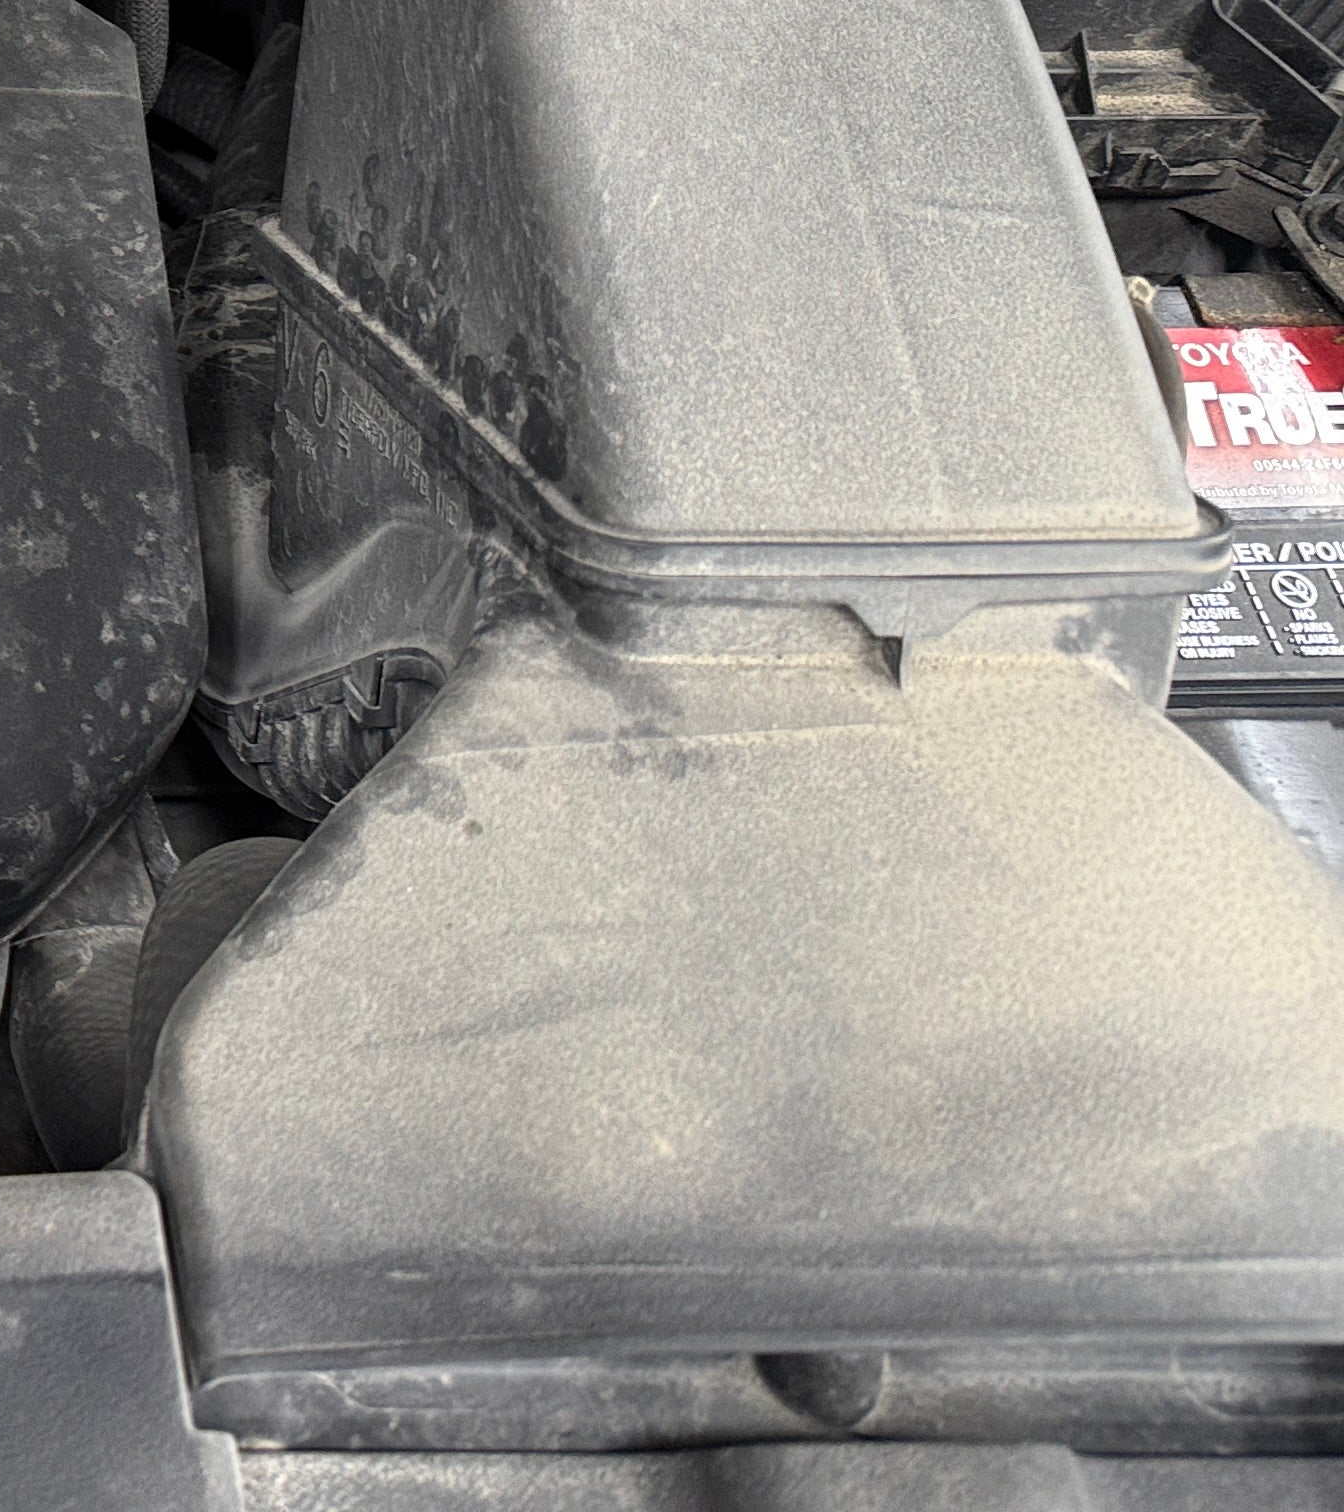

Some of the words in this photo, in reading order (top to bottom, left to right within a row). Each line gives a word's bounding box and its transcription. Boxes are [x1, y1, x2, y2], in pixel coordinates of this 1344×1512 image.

[1172, 342, 1312, 367] OYOTA
[1184, 381, 1344, 447] TRUE
[1252, 457, 1344, 472] 00544-24F6
[1232, 542, 1276, 563] ER
[1295, 541, 1344, 563] POI
[1189, 593, 1230, 607] EYES
[1181, 606, 1243, 620] PLOSIVE
[1292, 607, 1318, 621] NO
[1178, 620, 1221, 634] ASES
